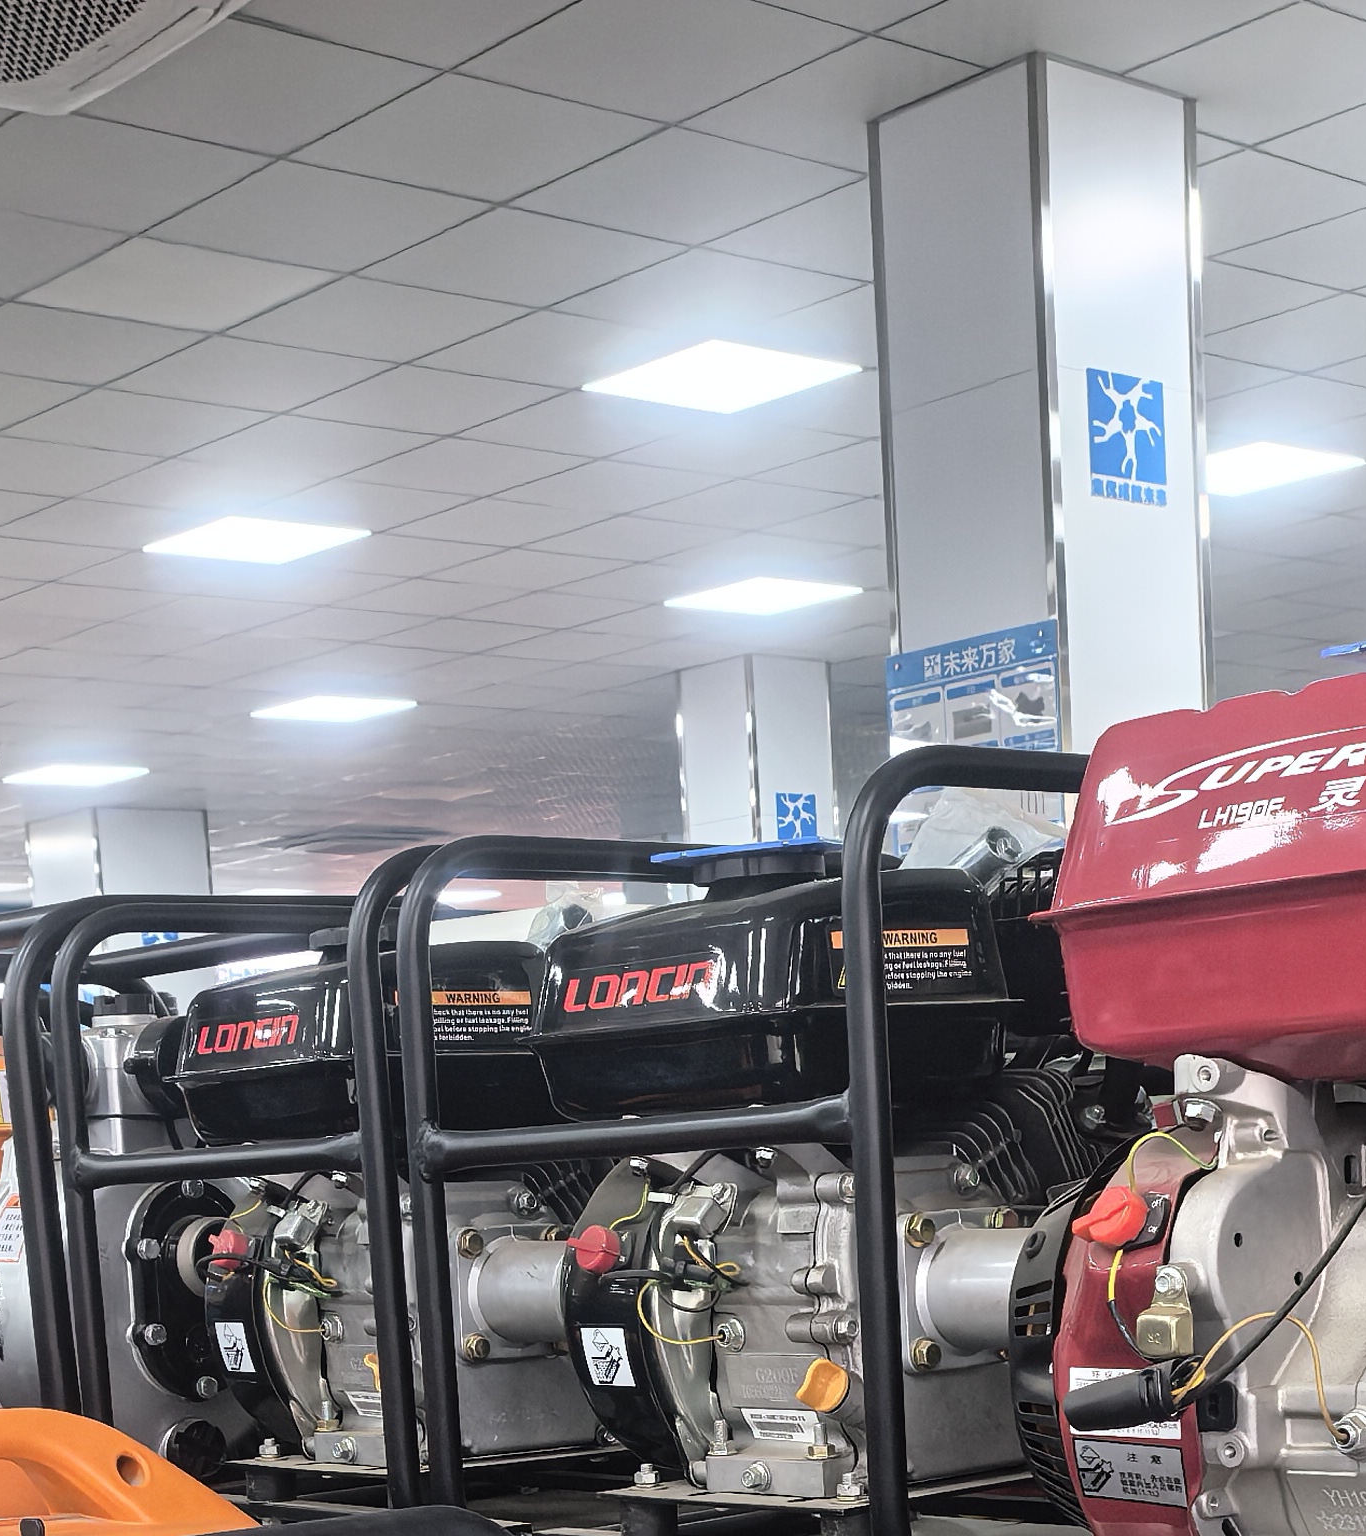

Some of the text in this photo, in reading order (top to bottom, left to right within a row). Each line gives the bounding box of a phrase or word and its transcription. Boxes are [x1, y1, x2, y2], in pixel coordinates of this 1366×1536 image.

[944, 638, 1016, 676] 未来万家
[883, 932, 938, 945] WARNING
[445, 992, 501, 1004] WARNING
